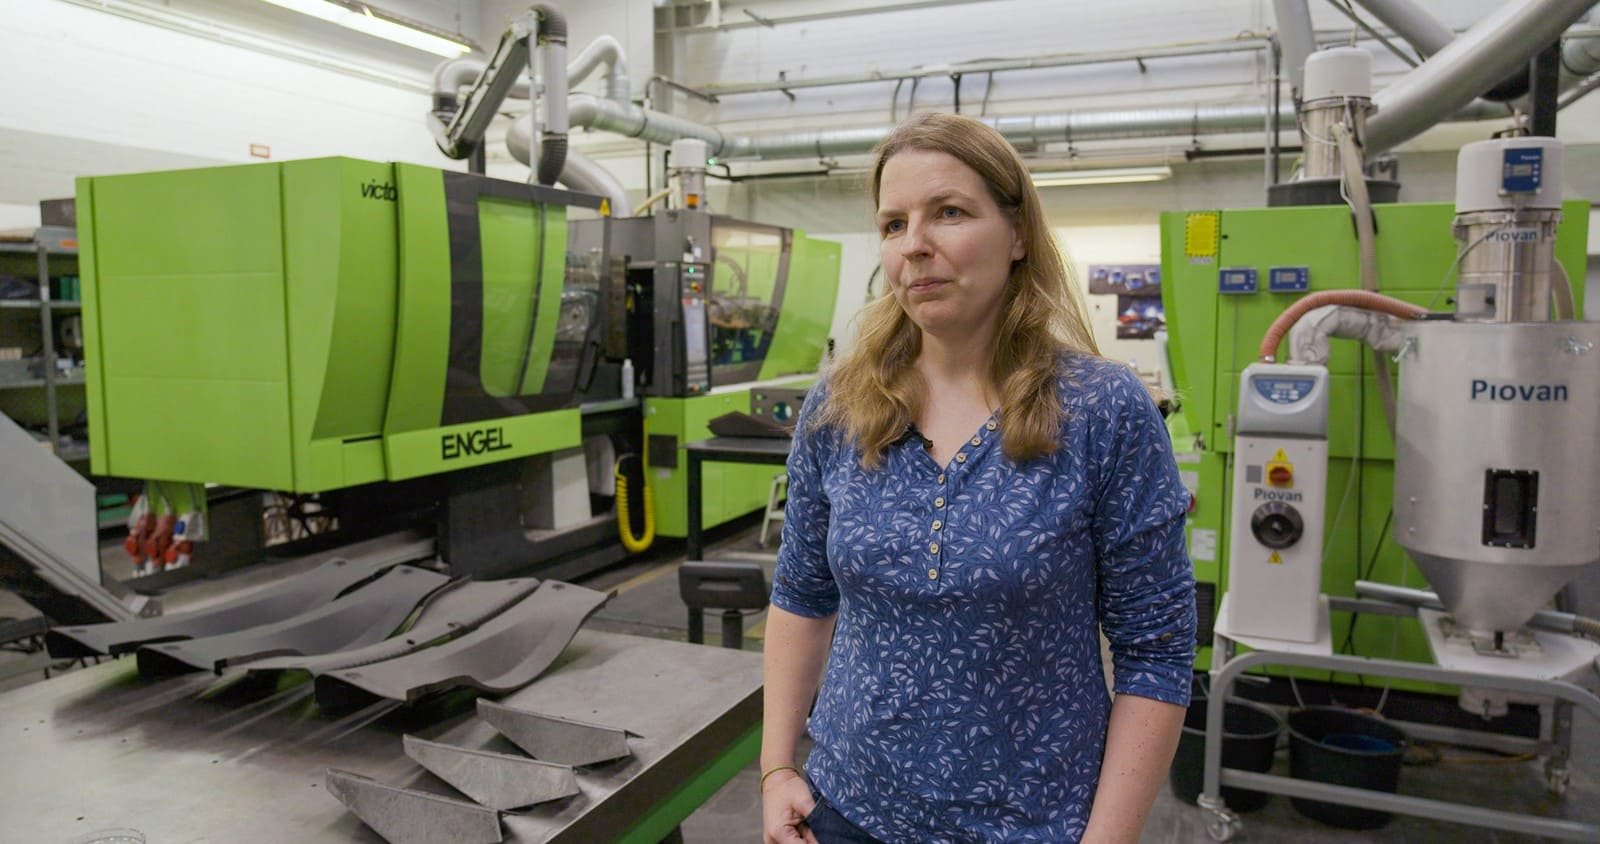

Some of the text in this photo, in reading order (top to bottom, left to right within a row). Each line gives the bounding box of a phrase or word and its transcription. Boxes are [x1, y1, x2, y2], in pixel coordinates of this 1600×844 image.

[1471, 379, 1568, 401] Piovan
[442, 427, 512, 460] ENGEL
[1254, 487, 1303, 501] Piovan
